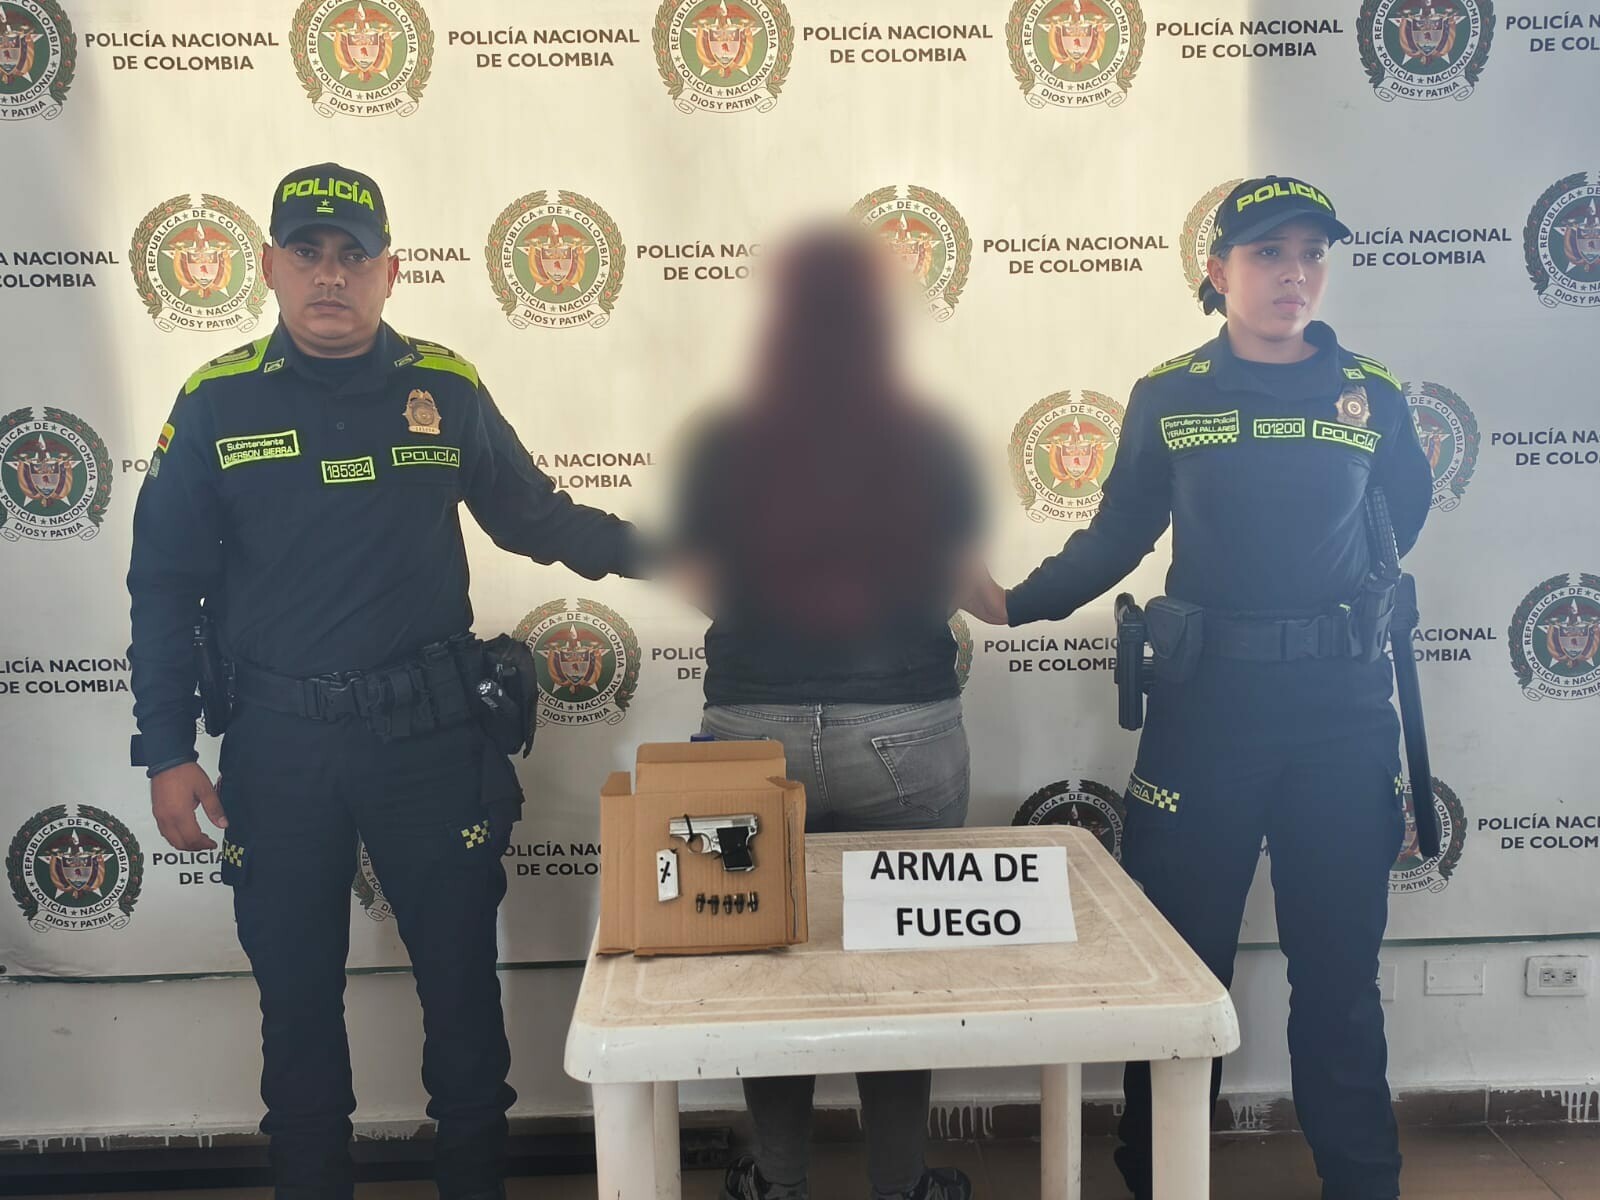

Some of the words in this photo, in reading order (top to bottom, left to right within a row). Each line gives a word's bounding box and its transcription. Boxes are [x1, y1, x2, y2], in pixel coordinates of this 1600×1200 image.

[748, 0, 777, 49] OLOMBIA
[1157, 18, 1233, 36] POLICÍA
[1240, 20, 1343, 34] NACIONAL
[1506, 11, 1583, 30] POLICÍA
[85, 30, 166, 47] POLICÍA
[172, 33, 279, 47] NACIONAL
[449, 27, 527, 45] POLICÍA
[534, 29, 639, 44] NACIONAL
[804, 23, 882, 40] POLICÍA
[888, 25, 993, 39] NACIONAL
[1182, 45, 1206, 58] DE
[1213, 42, 1317, 57] COLOMBIA
[1530, 38, 1555, 52] DE
[113, 56, 137, 70] DE
[144, 56, 253, 70] COLOMBIA
[477, 54, 502, 67] DE
[508, 52, 614, 67] COLOMBIA
[830, 49, 855, 63] DE
[861, 48, 966, 62] COLOMBIA
[1077, 57, 1124, 91] NACIONAL
[1427, 50, 1474, 84] NACIONAL
[11, 69, 56, 104] NACIONAL
[367, 66, 413, 100] NACIONAL
[726, 62, 773, 97] NACIONAL
[1077, 88, 1112, 104] PATRIA
[1426, 81, 1462, 98] PATRIA
[12, 100, 47, 118] PATRIA
[367, 97, 403, 114] PATRIA
[727, 93, 762, 110] PATRIA
[282, 178, 374, 212] POLICÍA
[193, 211, 207, 219] DE
[220, 217, 256, 271] COLOMBIA
[574, 212, 608, 267] COLOMBIA
[923, 207, 955, 261] COLOMBIA
[1340, 227, 1404, 245] OLICÍA
[1410, 228, 1511, 243] NACIONAL
[637, 241, 715, 258] POLICÍA
[984, 235, 1060, 252] POLICÍA
[1067, 236, 1168, 250] NACIONAL
[13, 251, 119, 265] NACIONAL
[394, 248, 471, 262] CIONAL
[1353, 253, 1376, 266] DE
[1383, 250, 1485, 265] COLOMBIA
[664, 267, 688, 280] DE
[695, 266, 750, 280] COLO
[1010, 261, 1033, 274] DE
[1040, 258, 1142, 273] COLOMBIA
[0, 274, 96, 288] OLOMBIA
[207, 284, 253, 316] NACIONAL
[560, 279, 605, 313] NACIONAL
[207, 313, 243, 329] PATRIA
[560, 309, 595, 326] PATRIA
[1095, 411, 1120, 437] COLO
[1257, 422, 1302, 435] 101200
[1410, 397, 1424, 405] DE
[1435, 402, 1463, 454] COLOMBIA
[226, 438, 284, 452] Subintendente
[1322, 426, 1374, 448] POLICÍA
[1491, 427, 1567, 446] POLICÍA
[60, 428, 96, 481] COLOMBIA
[263, 446, 294, 457] SIERRA
[401, 450, 458, 463] POLICÍA
[554, 452, 656, 467] NACIONAL
[1516, 453, 1540, 465] DE
[1546, 451, 1600, 465] COLO
[327, 461, 371, 479] 185324
[551, 474, 632, 488] LOMBIA
[50, 493, 93, 525] NACIONAL
[51, 522, 84, 538] PATRIA
[1569, 588, 1583, 596] DE
[567, 613, 581, 621] DE
[592, 618, 625, 668] COLOMBIA
[1413, 627, 1497, 642] ACIONAL
[985, 636, 1058, 652] POLICÍA
[652, 647, 706, 661] POLIC
[50, 658, 131, 673] NACION
[678, 668, 701, 679] DE
[1009, 660, 1032, 672] DE
[26, 680, 128, 693] COLOMBIA
[577, 680, 621, 711] NACIONAL
[577, 707, 611, 723] PATRIA
[1478, 813, 1550, 830] POLICÍA
[93, 824, 128, 873] COLOMBIA
[504, 841, 566, 857] OLICÍA
[1501, 837, 1524, 849] DE
[1529, 835, 1599, 849] COLOM
[517, 864, 540, 875] DE
[546, 863, 601, 876] COLO
[871, 851, 982, 881] ARMA
[995, 854, 1038, 882] DE
[180, 872, 204, 884] DE
[1401, 876, 1434, 891] PATRIA
[80, 884, 125, 916] NACIONAL
[81, 912, 115, 928] PATRIA
[897, 908, 1020, 936] FUEGO
